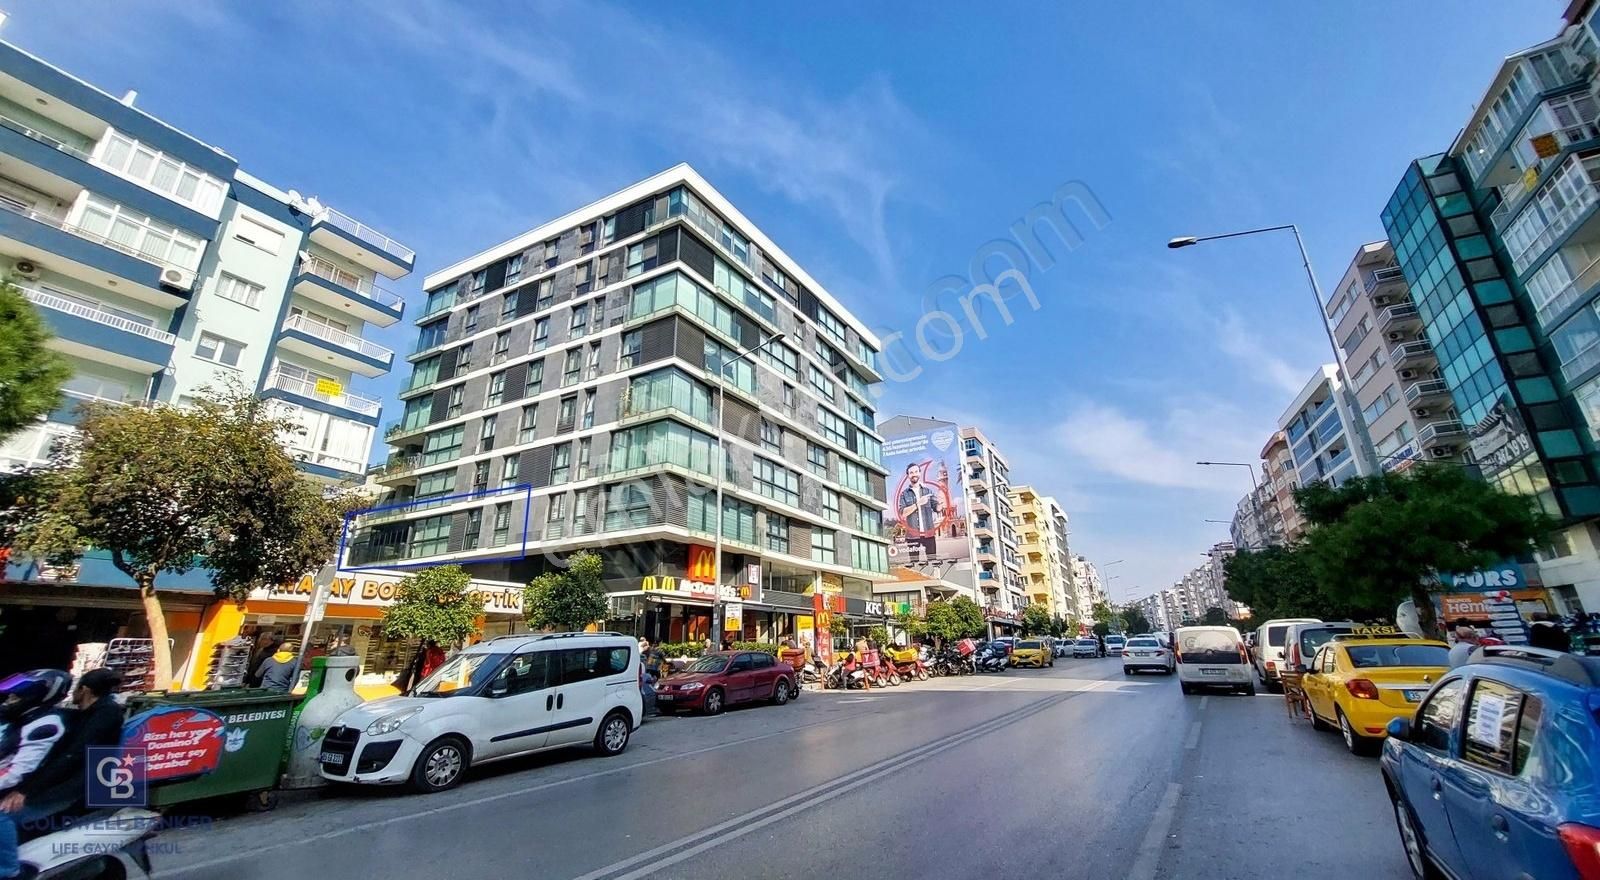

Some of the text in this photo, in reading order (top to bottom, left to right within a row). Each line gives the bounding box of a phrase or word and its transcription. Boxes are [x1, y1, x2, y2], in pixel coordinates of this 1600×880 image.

[864, 601, 882, 615] KFC
[168, 730, 189, 739] her
[166, 750, 188, 760] her
